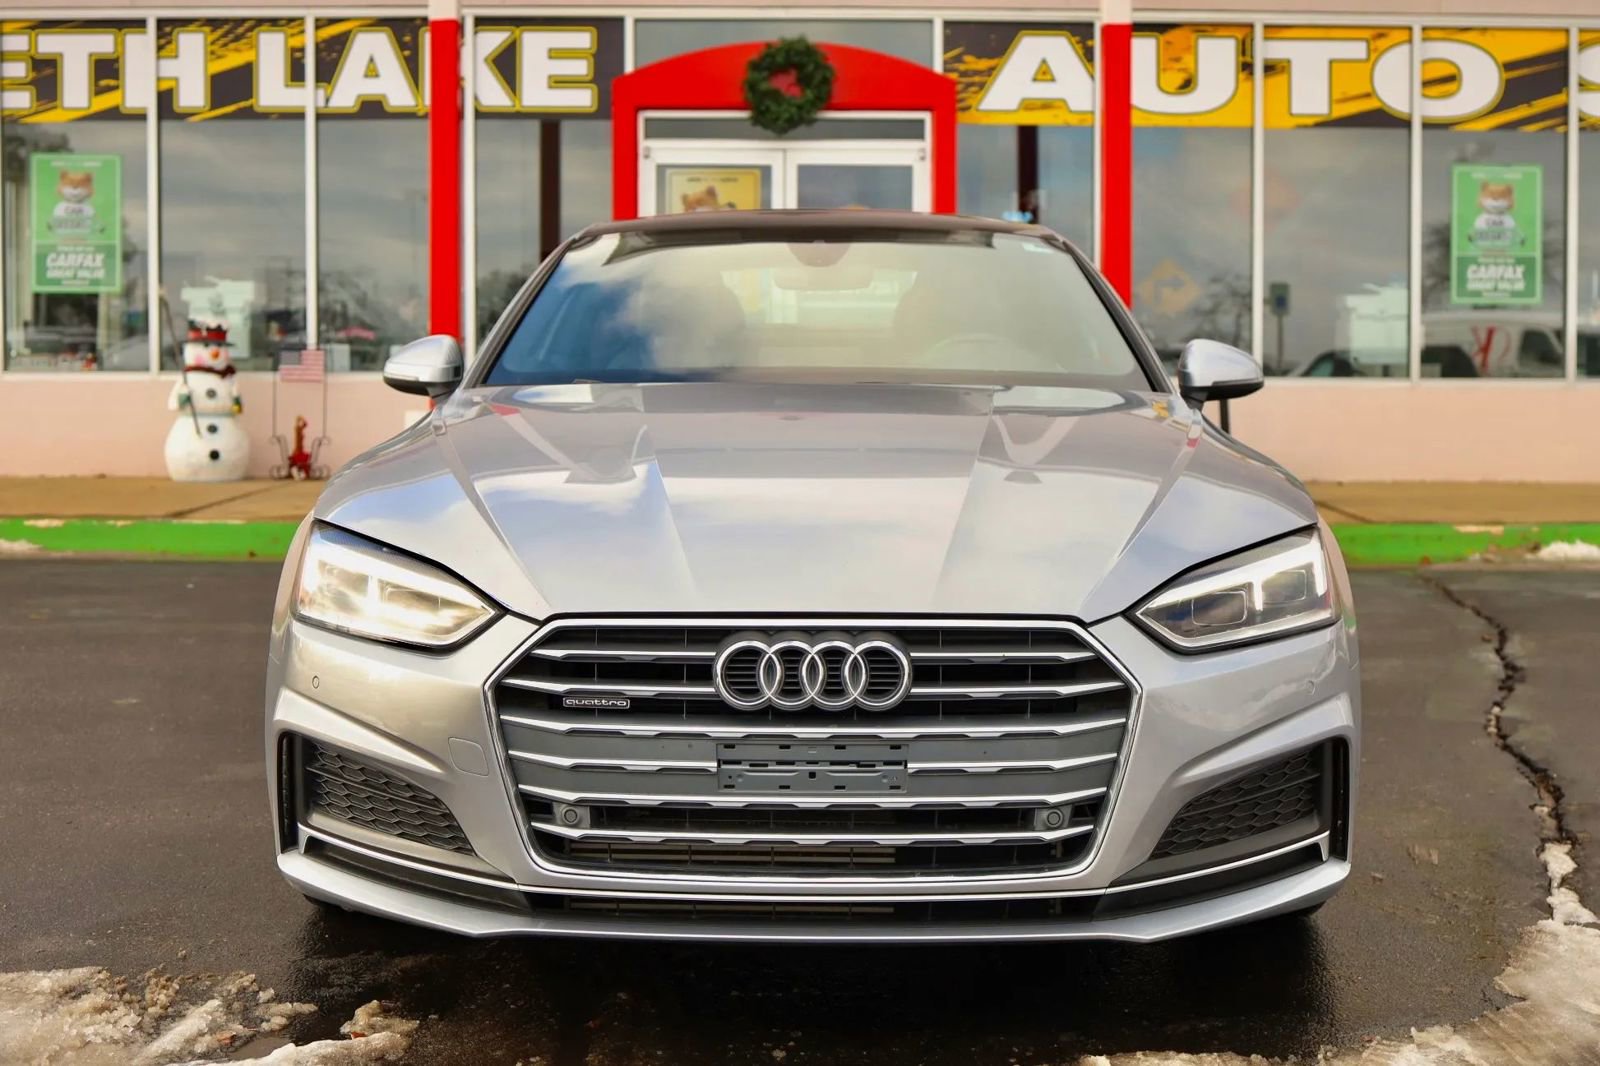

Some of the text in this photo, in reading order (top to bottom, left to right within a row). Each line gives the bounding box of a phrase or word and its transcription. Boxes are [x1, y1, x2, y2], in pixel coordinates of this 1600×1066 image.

[253, 27, 597, 112] LAKE
[973, 31, 1505, 123] AUTO
[46, 252, 105, 268] CARFAX
[1466, 264, 1526, 279] CARFAX
